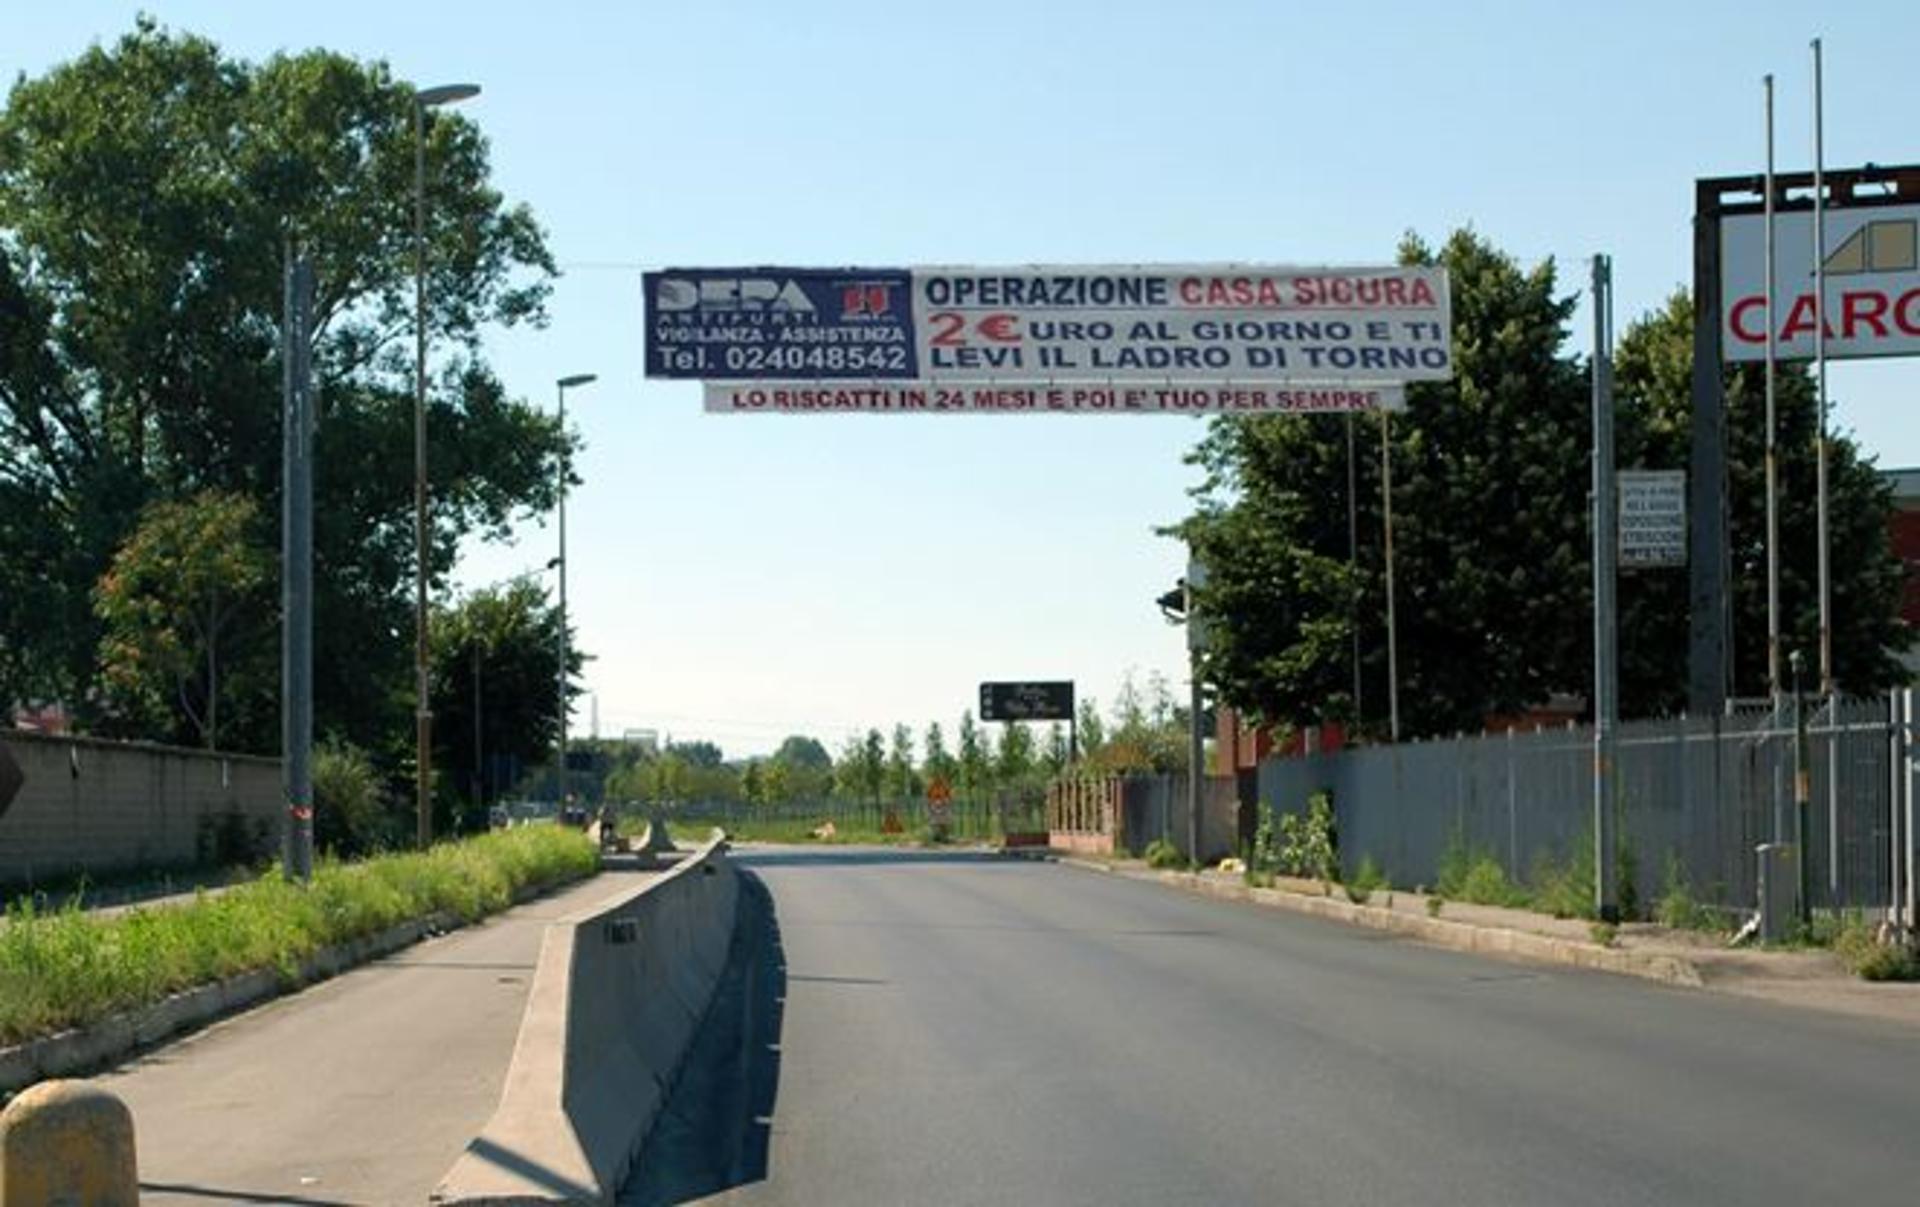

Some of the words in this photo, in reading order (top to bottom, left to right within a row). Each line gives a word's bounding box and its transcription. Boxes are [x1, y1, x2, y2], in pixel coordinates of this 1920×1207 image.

[925, 277, 1168, 305] OPERAZIONE
[1179, 277, 1280, 305] CASA
[1293, 277, 1436, 305] SICURA
[657, 328, 764, 342] VIGILANZA
[779, 328, 905, 342] ASSISTENZA
[1128, 322, 1178, 340] AL
[1192, 321, 1351, 340] GIORNO
[1366, 322, 1391, 340] E
[1403, 322, 1442, 340] TI
[658, 347, 715, 369] Tel.
[726, 347, 905, 369] 024048542
[931, 348, 1023, 367] LEVI
[1038, 348, 1076, 367] IL
[1092, 347, 1230, 368] LADRO
[1248, 348, 1287, 367] DI
[1302, 347, 1448, 368] TORNO
[733, 391, 766, 407] LO
[773, 390, 891, 407] RISCATTI
[901, 391, 926, 407] IN
[935, 391, 964, 408] 24
[974, 391, 1035, 408] MESI
[1049, 391, 1064, 408] E
[1074, 391, 1115, 408] POI
[1155, 391, 1208, 408] TUO
[1218, 391, 1267, 408] PER
[1277, 391, 1379, 408] SEMPRE
